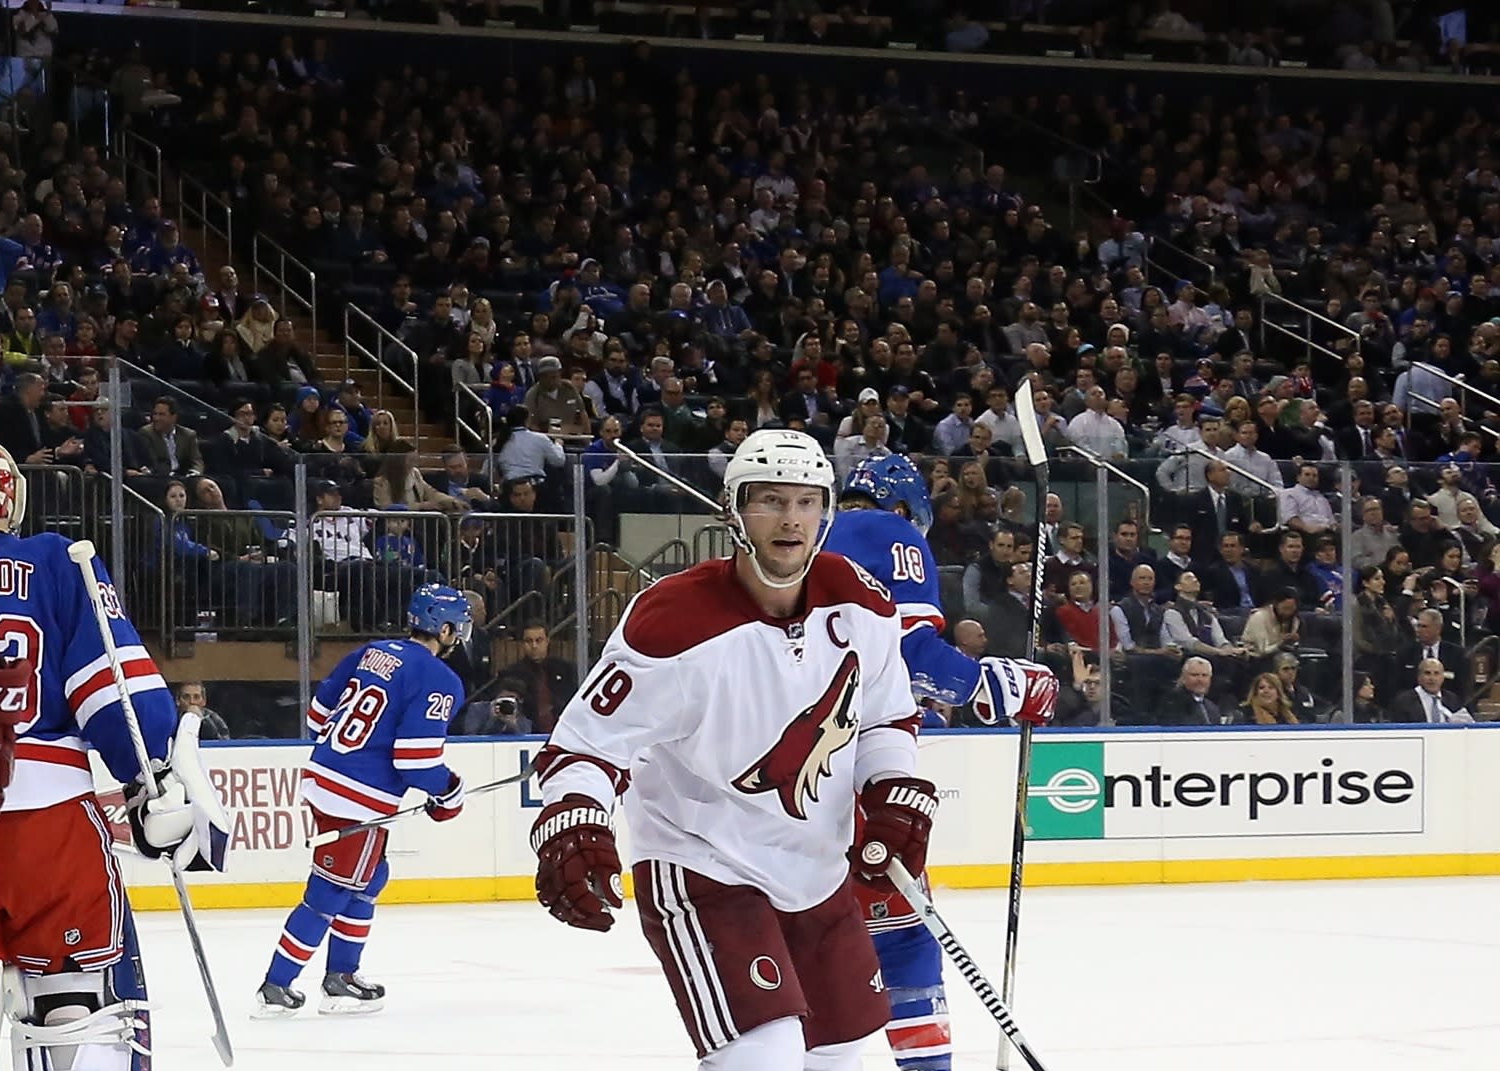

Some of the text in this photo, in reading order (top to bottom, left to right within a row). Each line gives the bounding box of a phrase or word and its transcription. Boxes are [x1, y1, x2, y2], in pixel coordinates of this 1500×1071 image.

[891, 542, 926, 584] 18
[826, 611, 850, 648] C
[425, 692, 455, 722] 28
[581, 661, 633, 717] 19
[316, 677, 389, 755] 28
[209, 767, 309, 808] BREW
[1028, 756, 1415, 821] enterprise
[938, 930, 1020, 1038] WARRIOR
